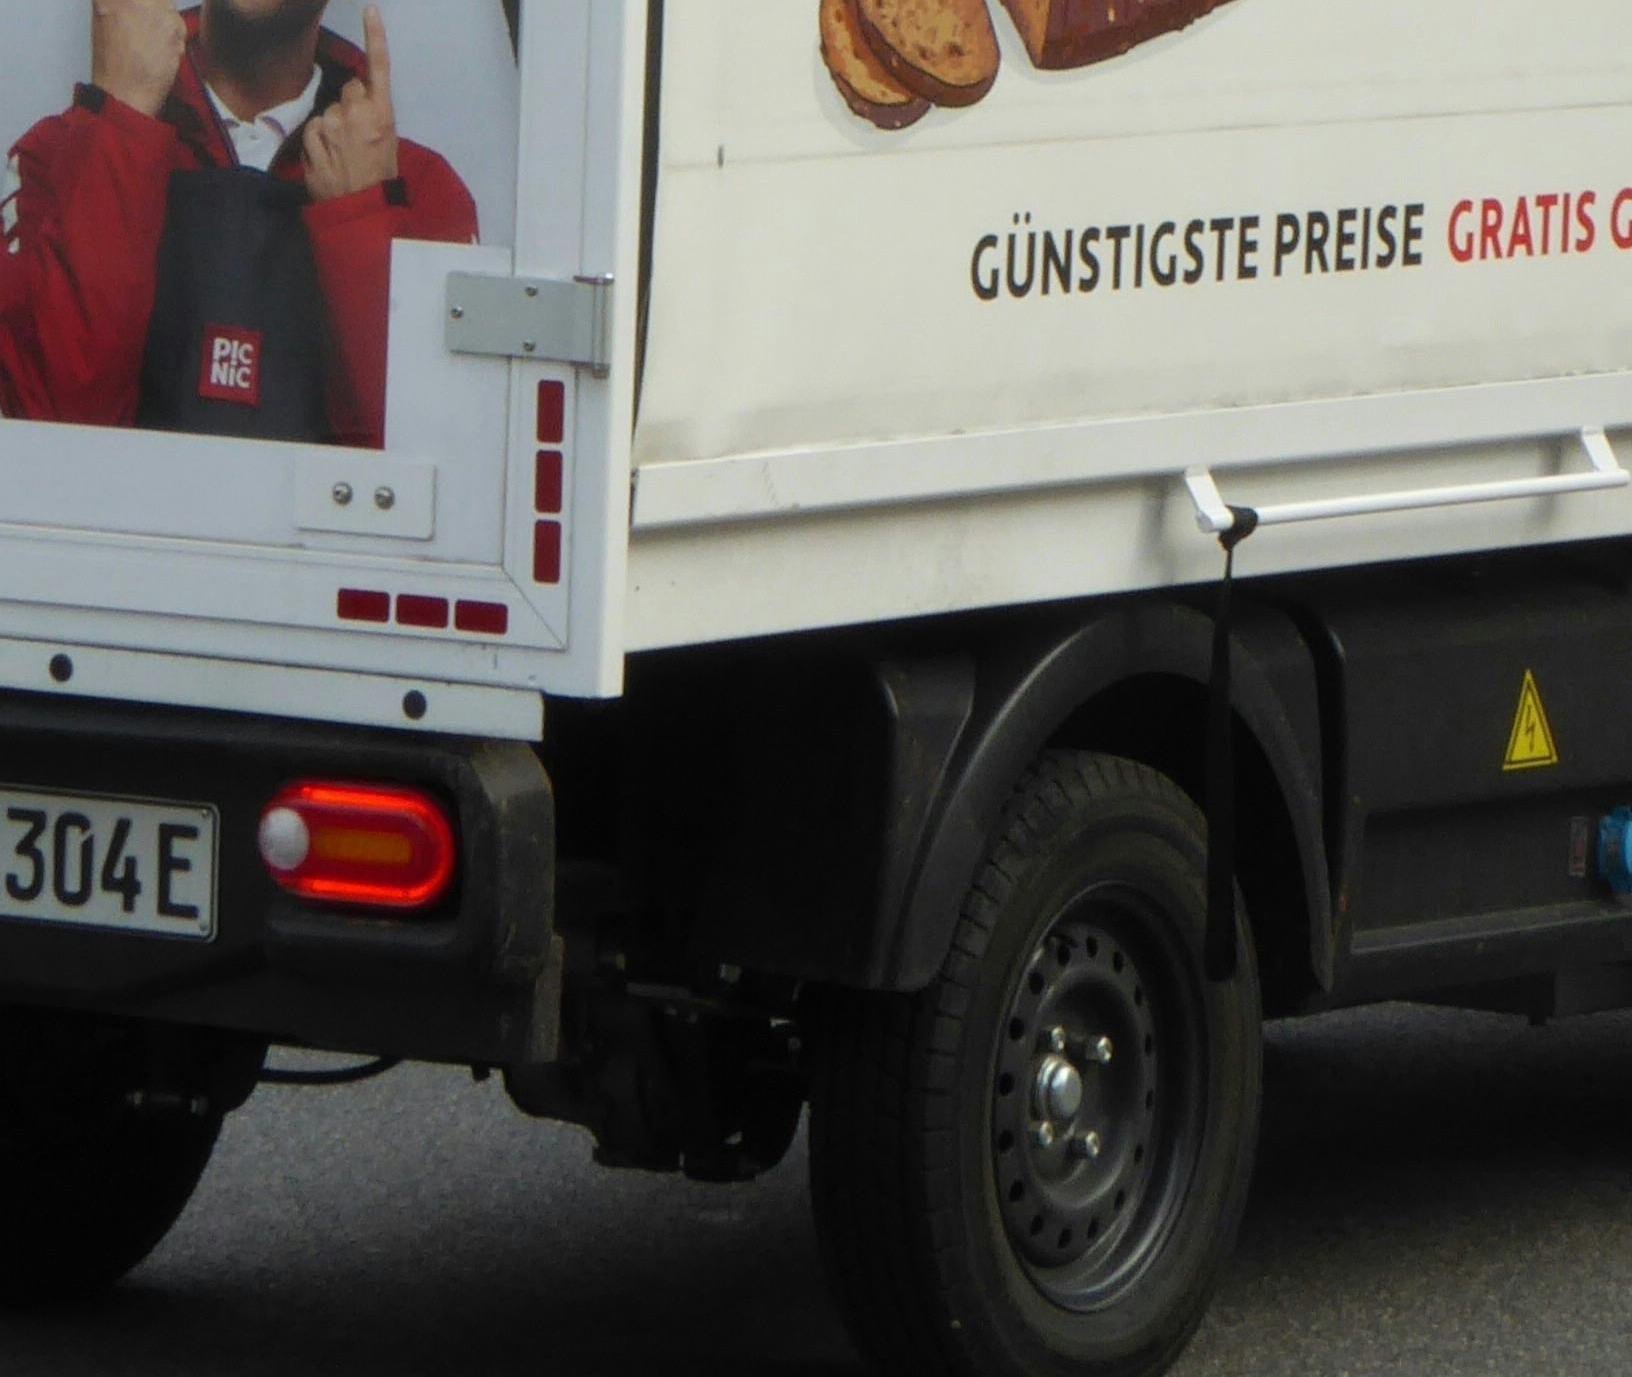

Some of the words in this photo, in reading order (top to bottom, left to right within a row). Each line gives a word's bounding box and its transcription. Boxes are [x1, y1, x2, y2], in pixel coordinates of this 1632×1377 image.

[970, 211, 1259, 302] GÜNSTIGSTE
[1272, 202, 1426, 275] PREISE
[1447, 188, 1596, 263] GRATIS
